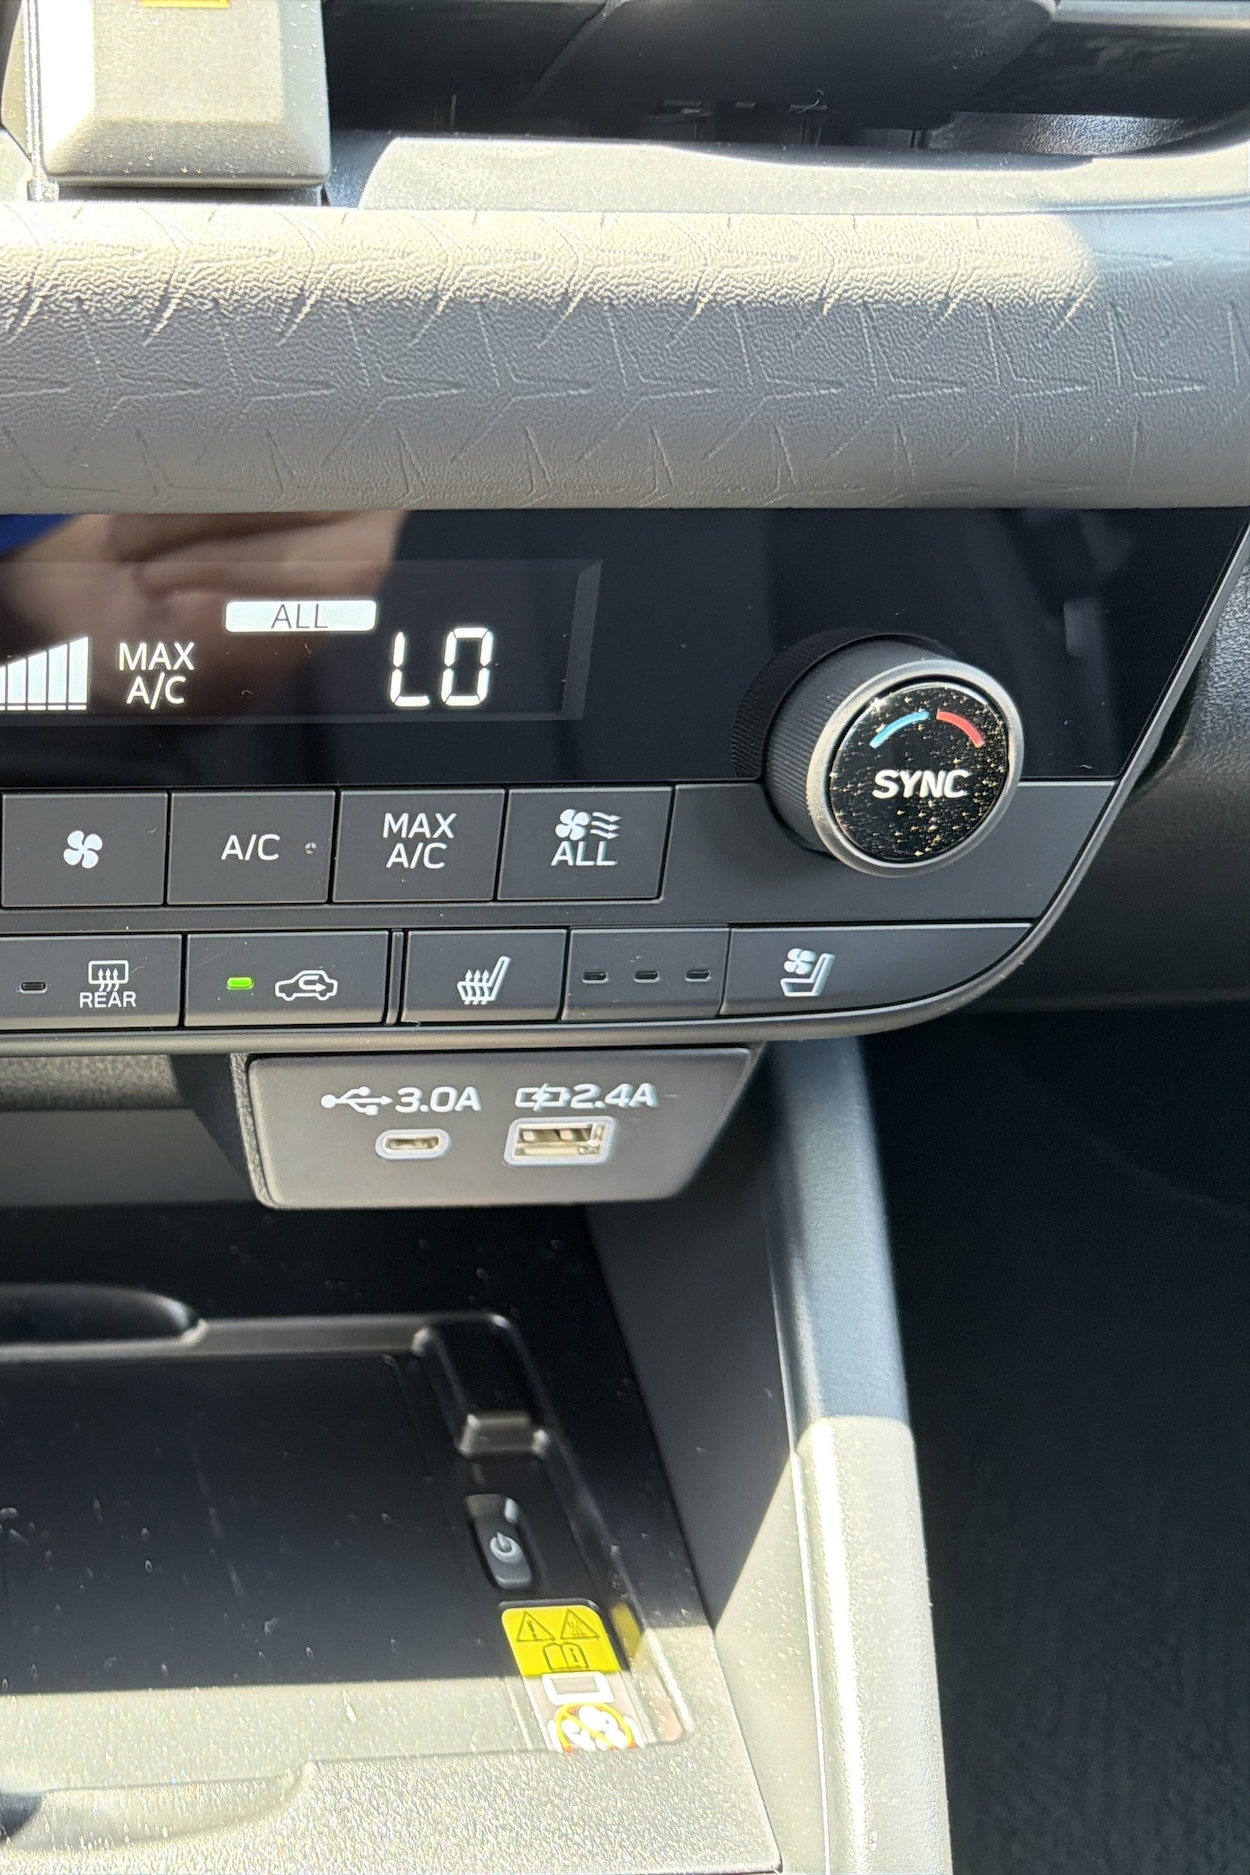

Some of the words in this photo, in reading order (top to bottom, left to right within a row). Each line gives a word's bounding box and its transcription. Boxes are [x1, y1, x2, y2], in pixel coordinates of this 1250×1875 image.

[270, 602, 329, 630] ALL
[117, 641, 195, 672] MAX
[125, 674, 187, 711] A/C
[872, 768, 972, 799] SYNC
[381, 812, 458, 840] MAX
[220, 833, 281, 862] A/C
[385, 842, 447, 870] A/C
[550, 840, 618, 867] ALL
[78, 990, 138, 1009] REAR
[394, 1085, 483, 1114] 3.0A
[568, 1082, 658, 1109] 2.4A
